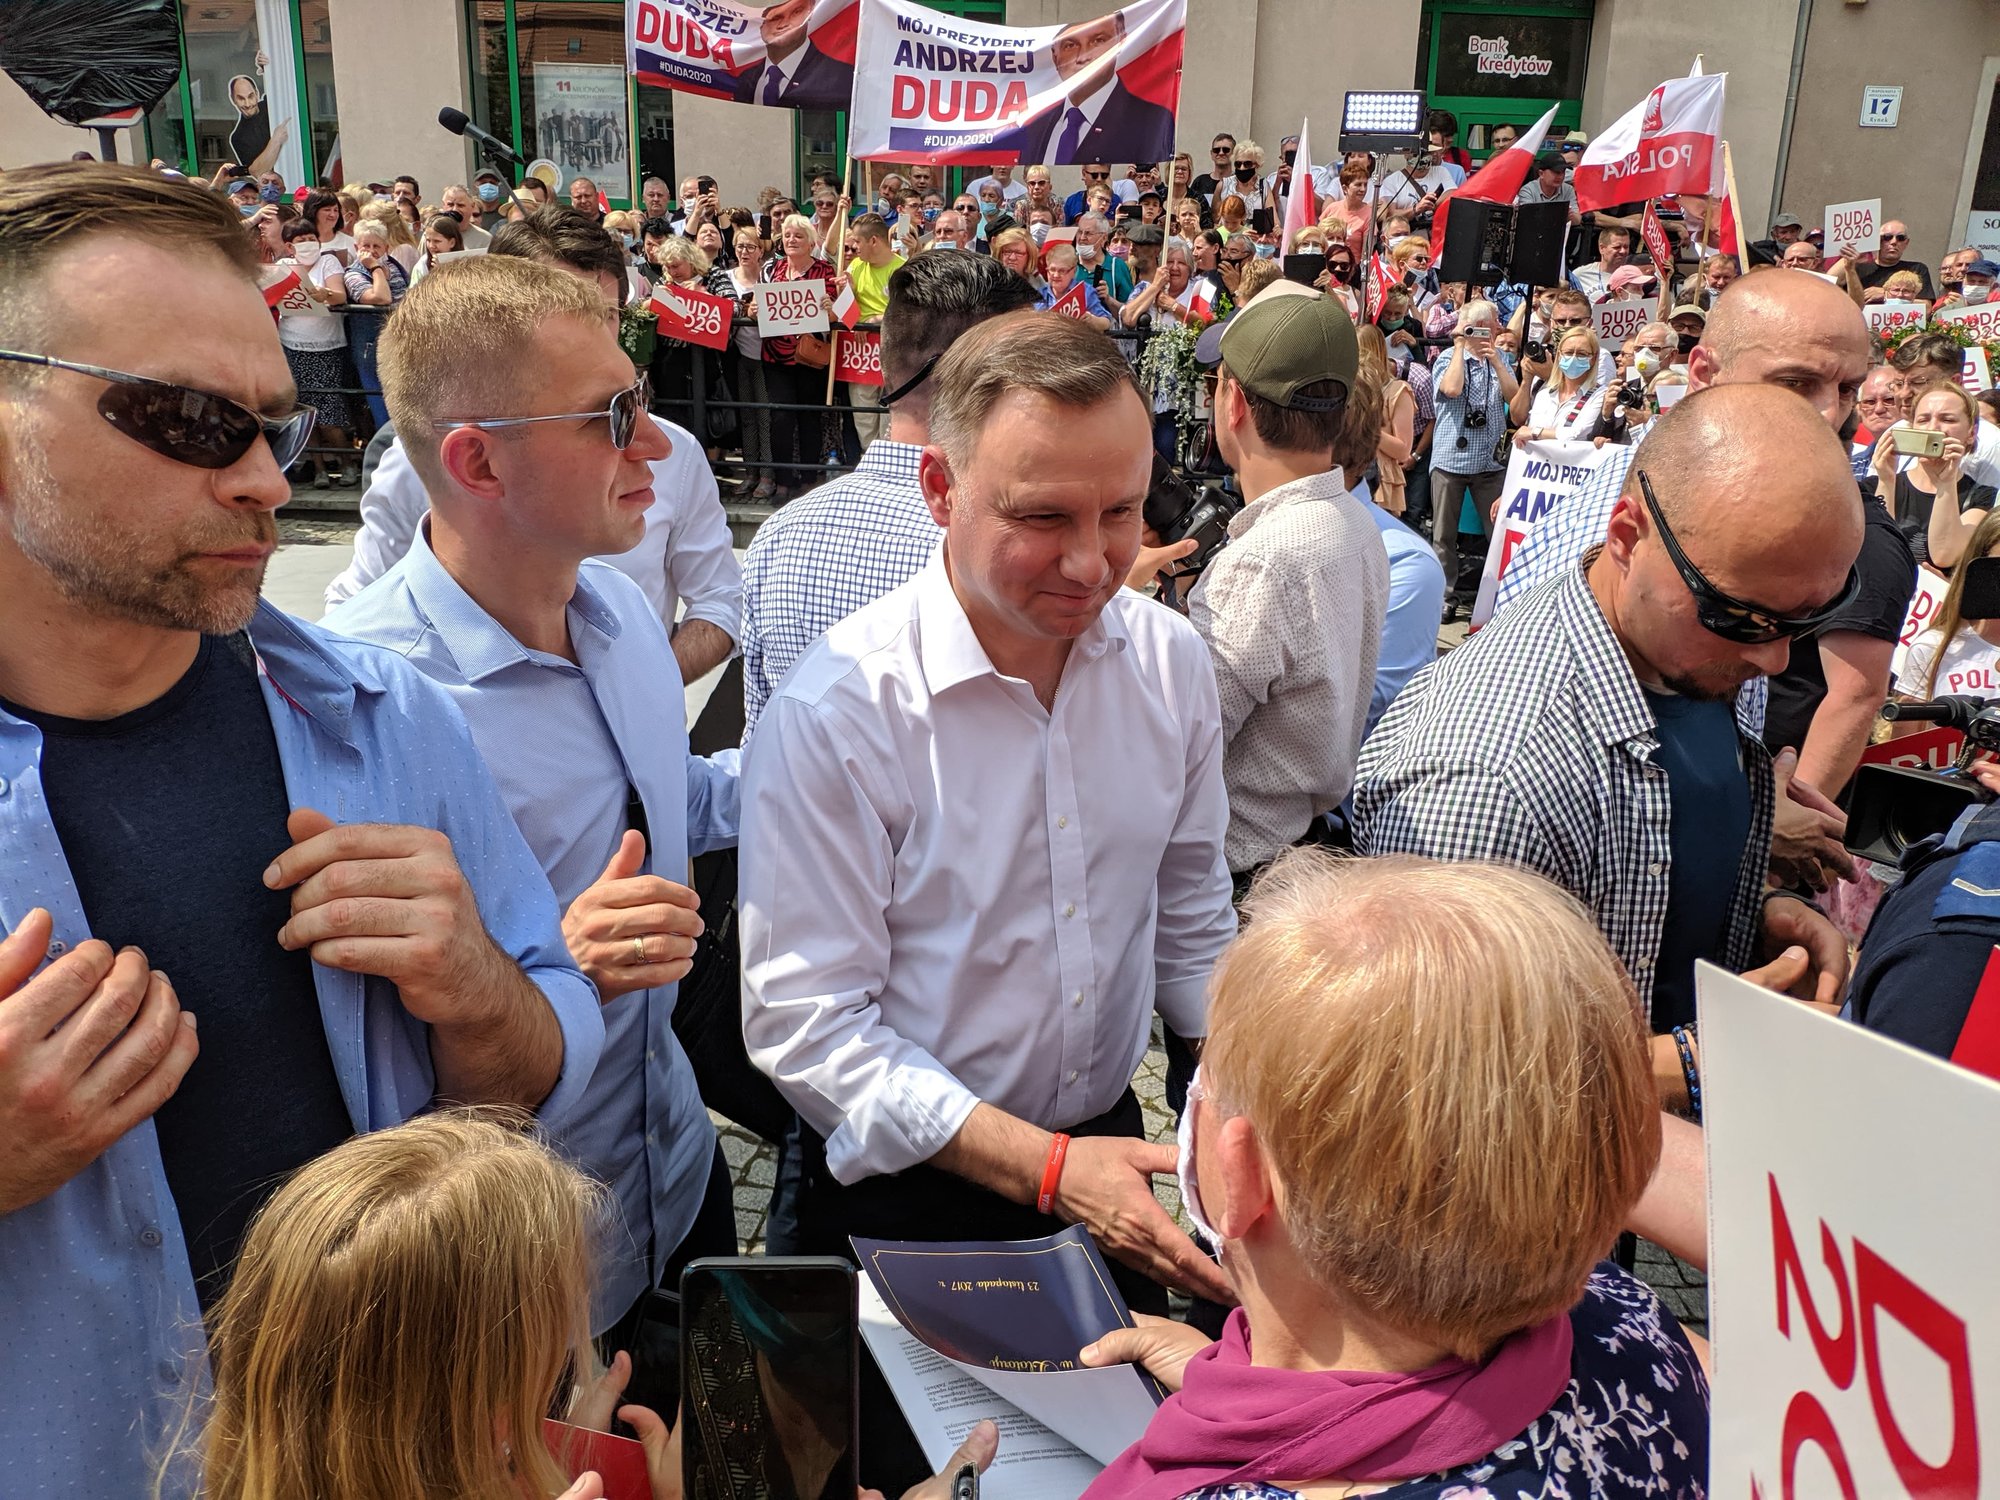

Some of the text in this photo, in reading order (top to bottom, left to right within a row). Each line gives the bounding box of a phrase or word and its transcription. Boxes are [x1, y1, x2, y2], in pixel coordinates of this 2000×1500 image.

[635, 2, 737, 71] DUDA
[897, 15, 1035, 47] MÓJ PREZYDENT
[1470, 37, 1507, 52] Bank
[894, 39, 1034, 73] ANDRZEJ
[1479, 55, 1550, 75] Kredytów
[659, 61, 712, 84] #DUDA2020
[556, 81, 571, 91] 11
[891, 74, 1028, 122] DUDA
[1869, 98, 1893, 115] 17
[924, 133, 993, 147] #DUDA2020
[1834, 209, 1872, 228] DUDA
[1834, 223, 1873, 242] 2020
[766, 288, 816, 307] DUDA
[768, 303, 819, 321] 2020
[1601, 308, 1647, 326] DUDA
[843, 340, 880, 357] DUDA
[842, 354, 881, 372] 2020
[1523, 459, 1558, 482] MÓJ
[1949, 669, 1998, 693] POL
[951, 1281, 973, 1291] 2017
[975, 1277, 1025, 1292] listopada
[1027, 1281, 1039, 1291] 23
